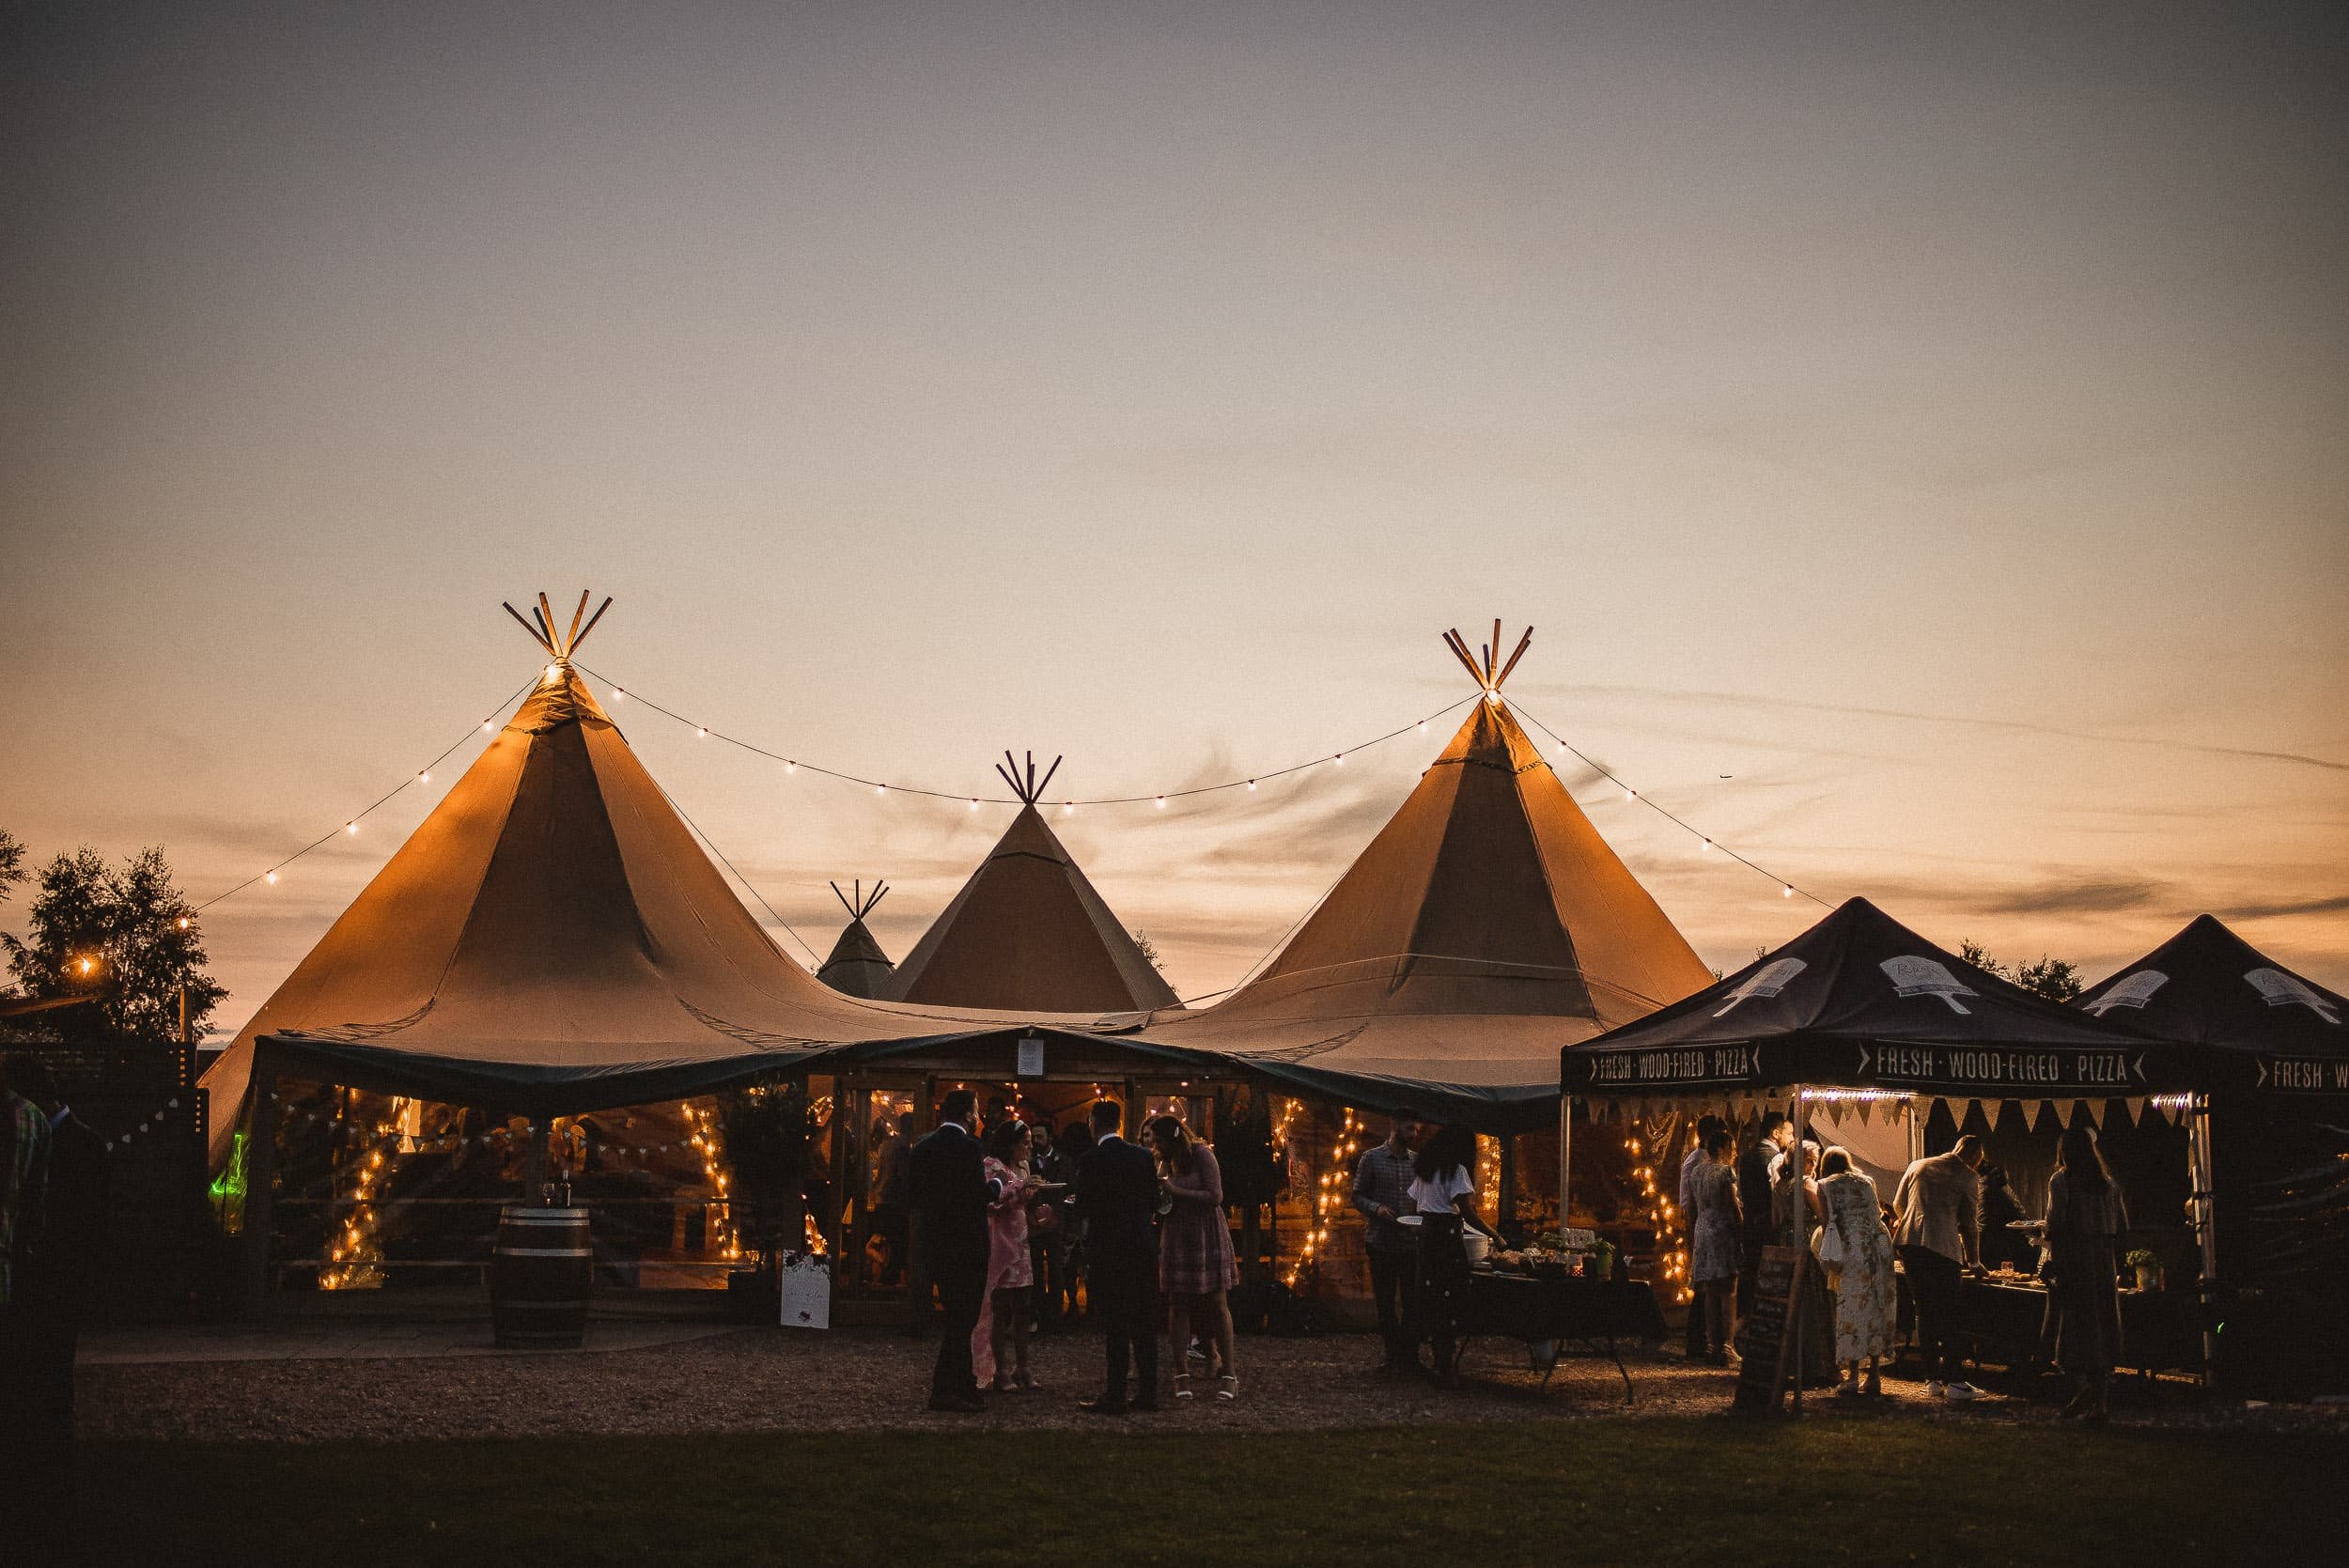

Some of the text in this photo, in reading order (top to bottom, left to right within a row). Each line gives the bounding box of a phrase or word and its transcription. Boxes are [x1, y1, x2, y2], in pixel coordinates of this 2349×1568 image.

[1600, 1048, 1749, 1079] FRESH WOOD-FIRED PIZZA
[1877, 1046, 2127, 1081] FRESH WOOD-FIRED PIZZA
[2274, 1060, 2322, 1089] FRESH
